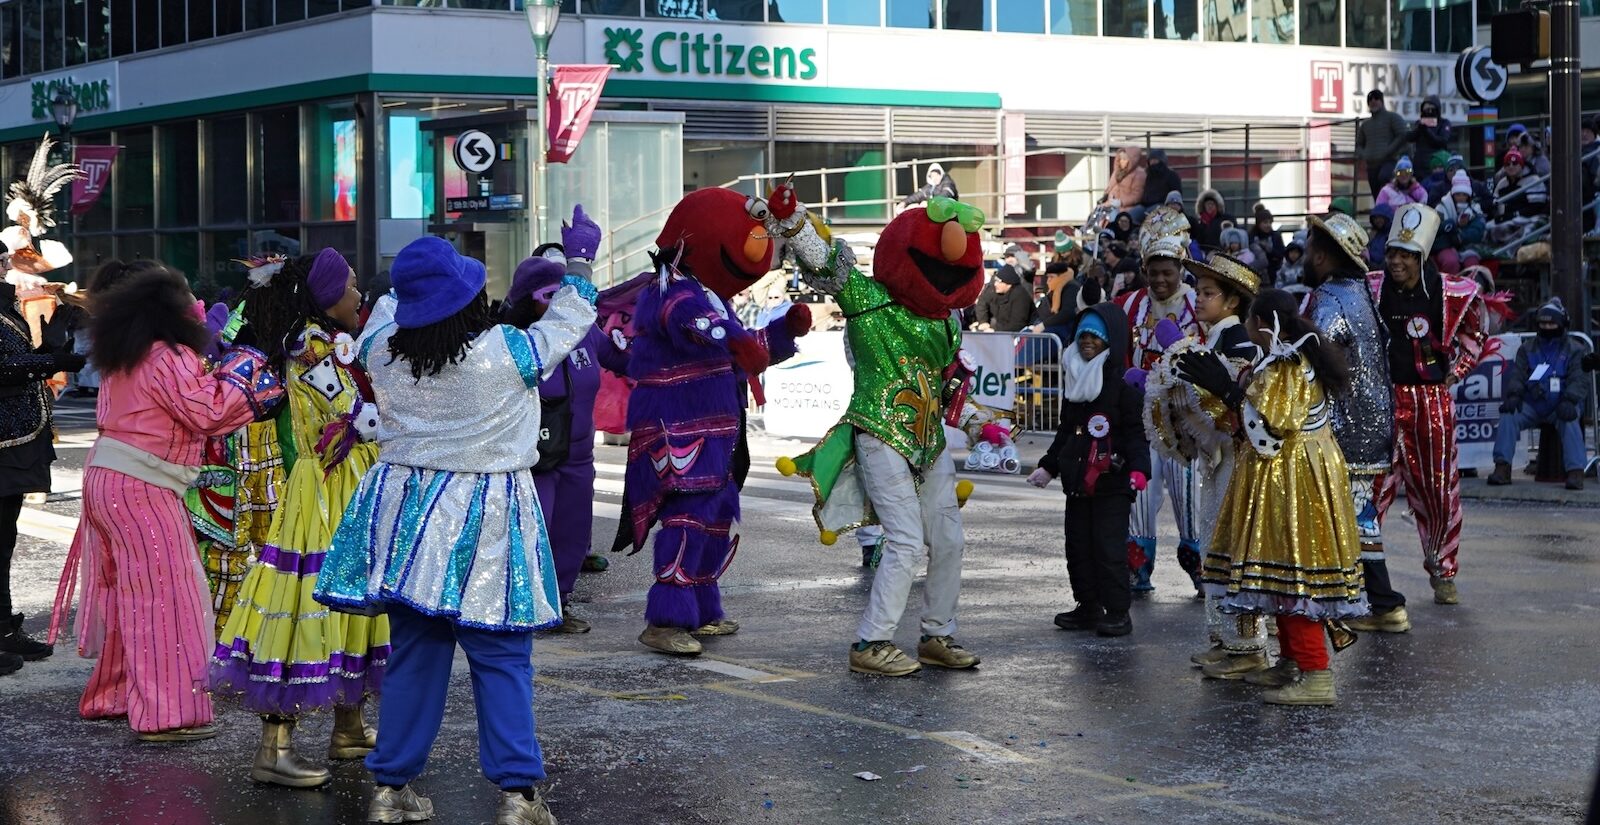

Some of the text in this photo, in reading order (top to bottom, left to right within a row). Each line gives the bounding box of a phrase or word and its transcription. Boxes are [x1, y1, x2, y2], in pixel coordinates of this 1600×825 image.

[652, 31, 817, 79] Citizens
[1348, 62, 1463, 99] TEMPL
[781, 382, 832, 394] POCONO
[774, 397, 841, 411] MOUNTAINS
[1456, 422, 1499, 440] 830
